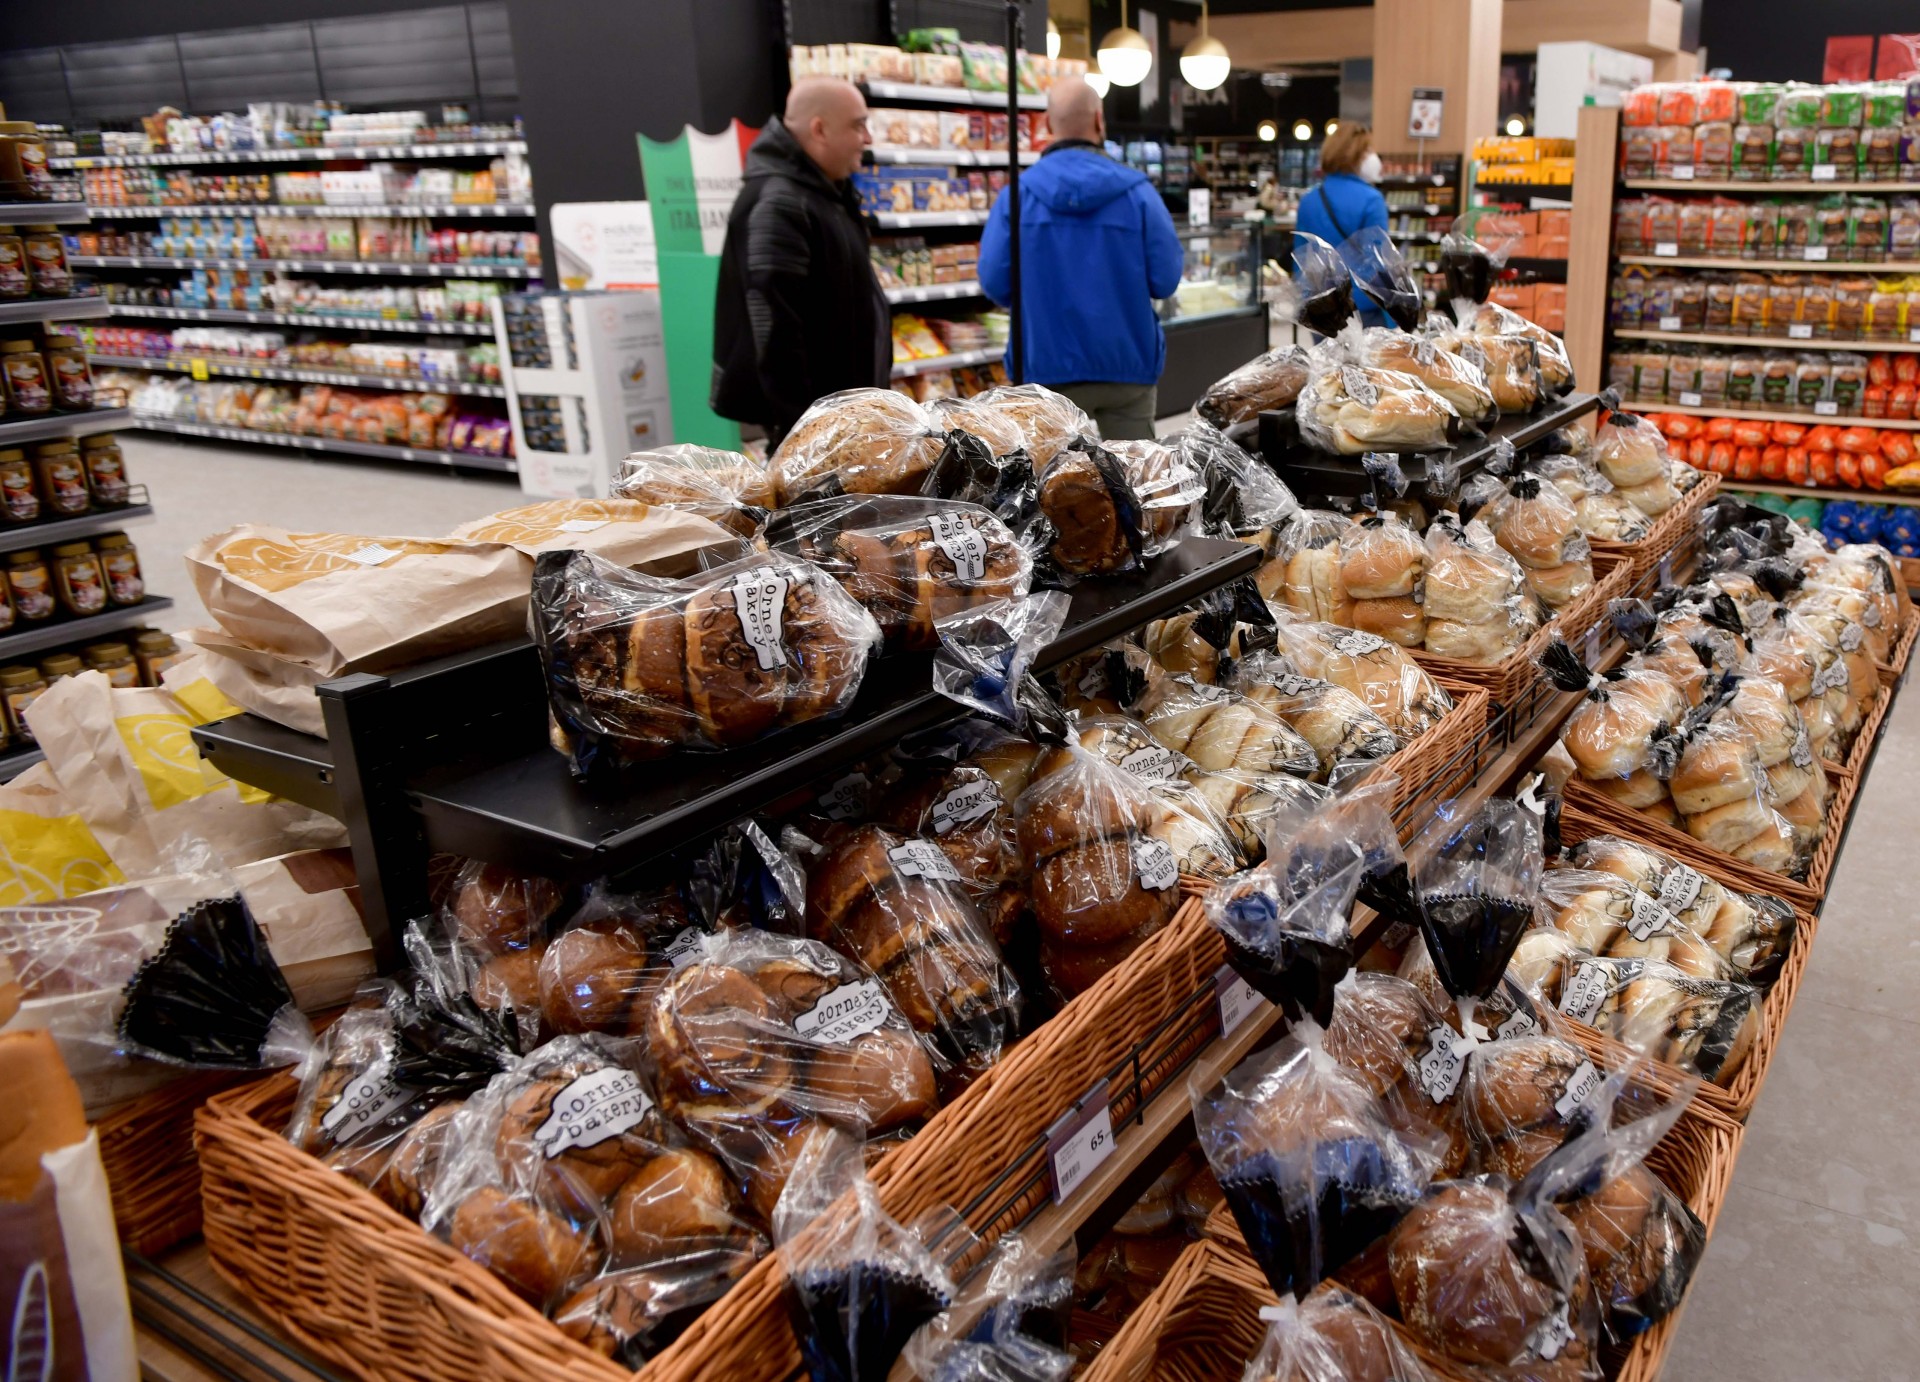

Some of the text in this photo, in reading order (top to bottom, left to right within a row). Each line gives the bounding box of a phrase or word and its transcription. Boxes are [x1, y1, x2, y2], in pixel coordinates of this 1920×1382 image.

[957, 521, 981, 561] orner
[745, 586, 767, 648] akery
[761, 580, 778, 647] orner
[907, 847, 943, 858] corne
[817, 989, 871, 1025] corner
[1565, 973, 1588, 1017] orner
[1577, 984, 1603, 1019] akery
[820, 998, 883, 1040] bakery
[559, 1074, 635, 1123] corner
[1571, 1071, 1598, 1103] corne
[567, 1093, 643, 1139] bakery
[1090, 1129, 1104, 1151] 65
